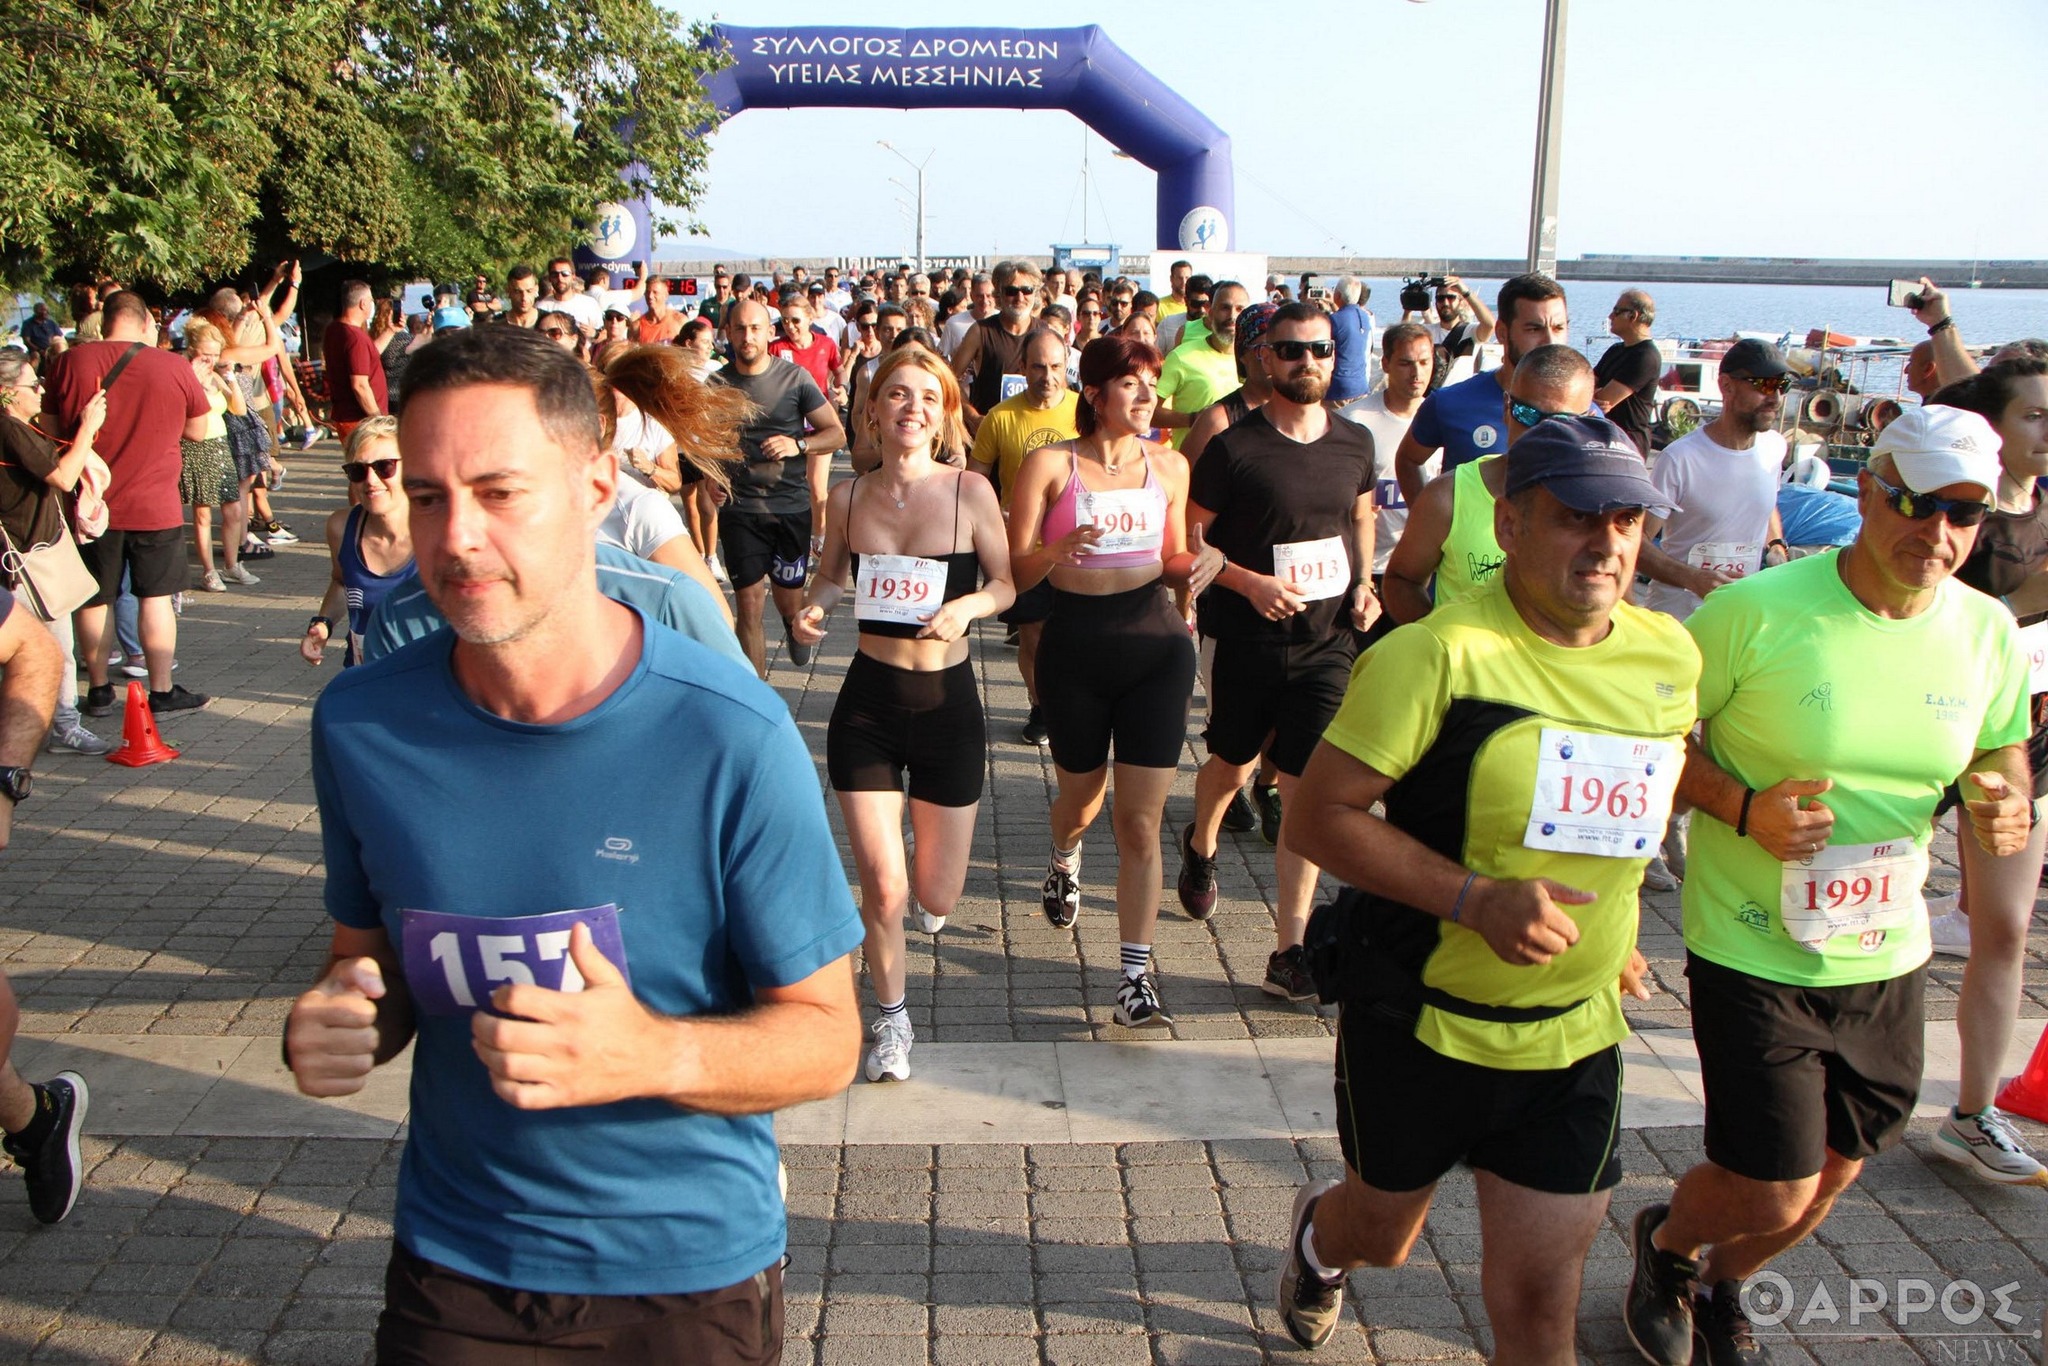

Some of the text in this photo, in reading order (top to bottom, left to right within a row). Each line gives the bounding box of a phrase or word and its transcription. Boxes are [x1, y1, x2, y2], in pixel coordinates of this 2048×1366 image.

[752, 36, 1058, 60] ΣΥΛΛΟΓΟΣ ΔΡΟΜΕΩΝ
[768, 63, 1043, 88] ΥΓΕΙΑΣ ΜΕΣΣΗΝΙΑΣ
[1091, 511, 1147, 535] 1904
[772, 559, 805, 582] 204
[1288, 559, 1339, 584] 1913
[867, 576, 930, 603] 1939
[1557, 775, 1649, 819] 1963
[1873, 844, 1893, 857] FIT
[1804, 874, 1891, 911] 1991
[430, 926, 593, 1007] 157
